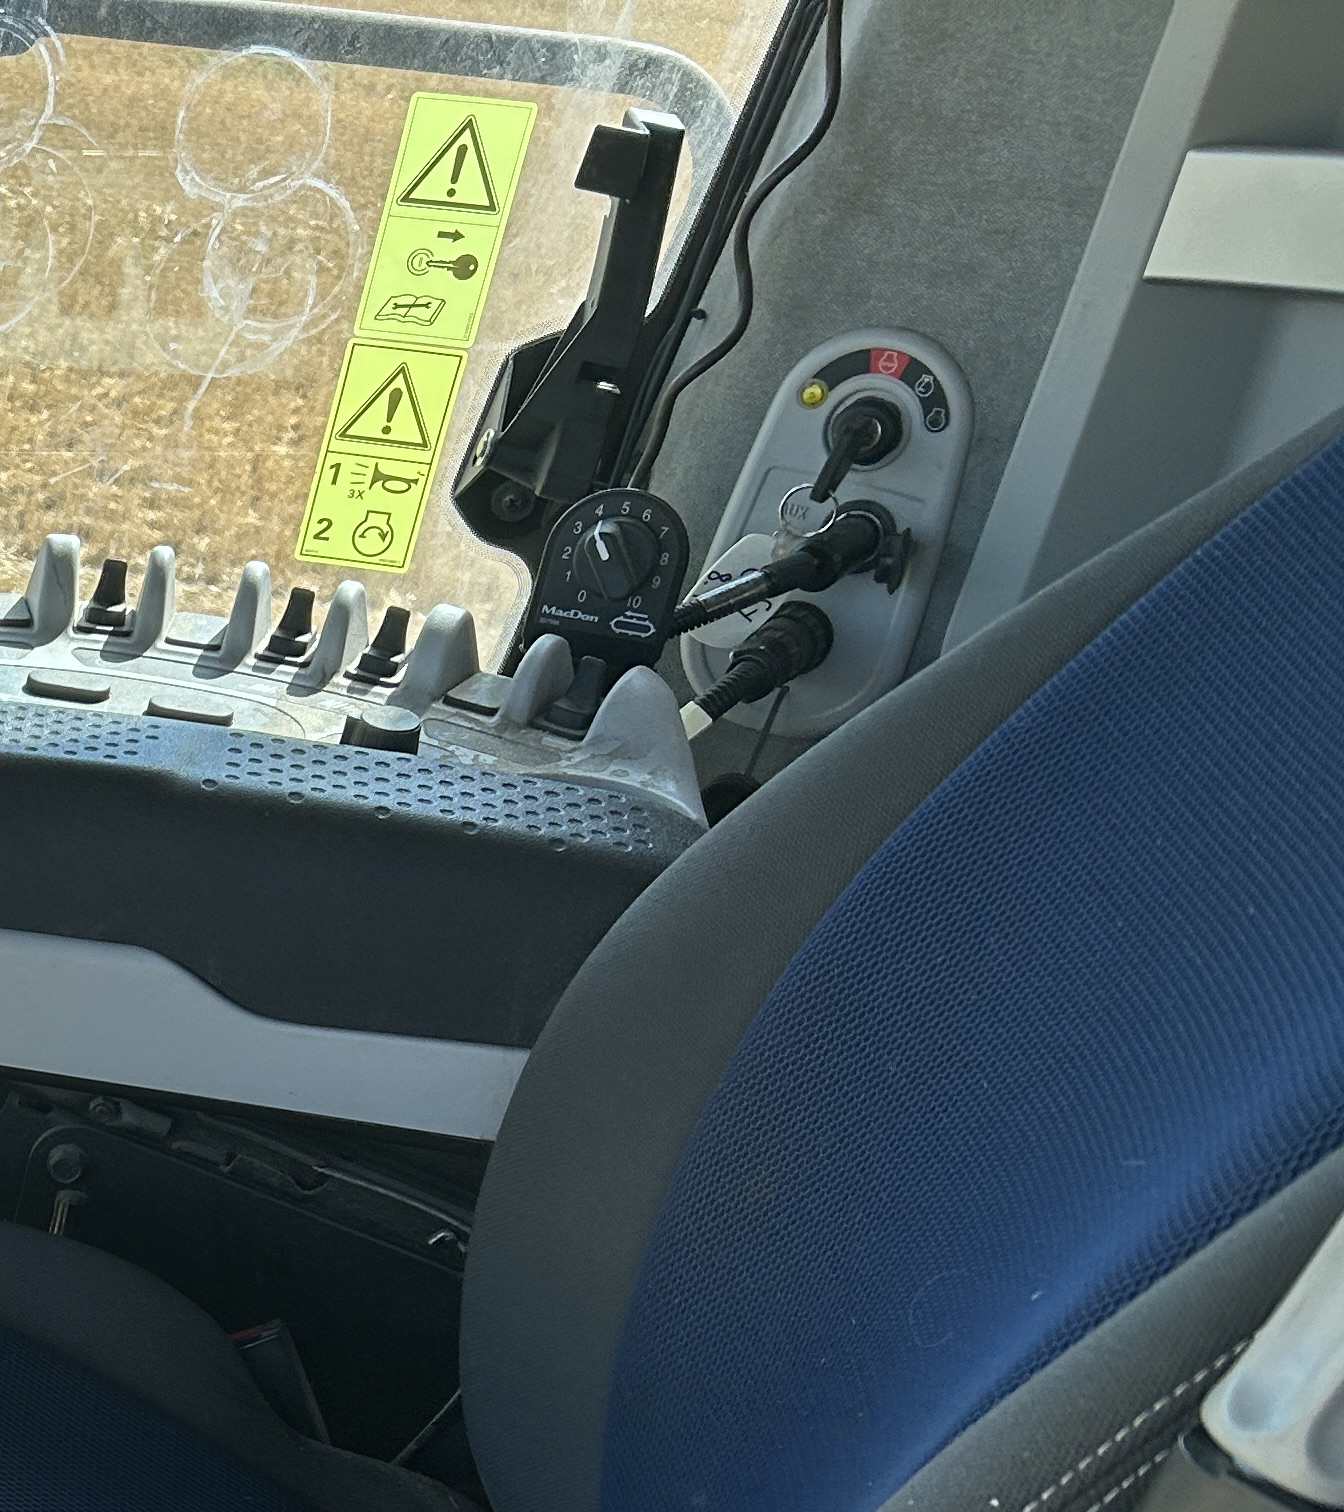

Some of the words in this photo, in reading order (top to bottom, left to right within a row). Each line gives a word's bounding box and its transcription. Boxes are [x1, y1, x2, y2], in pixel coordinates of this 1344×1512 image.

[329, 463, 341, 485] 1
[595, 503, 605, 516] 4
[620, 501, 631, 514] 5
[642, 509, 652, 521] 6
[312, 517, 333, 541] 2
[573, 521, 582, 534] 3
[660, 526, 669, 539] 7
[562, 546, 572, 559] 2
[660, 552, 669, 565] 8
[565, 570, 571, 582] 1
[652, 576, 661, 589] 9
[577, 589, 587, 602] 0
[627, 596, 642, 608] 10
[541, 604, 599, 622] MacDon
